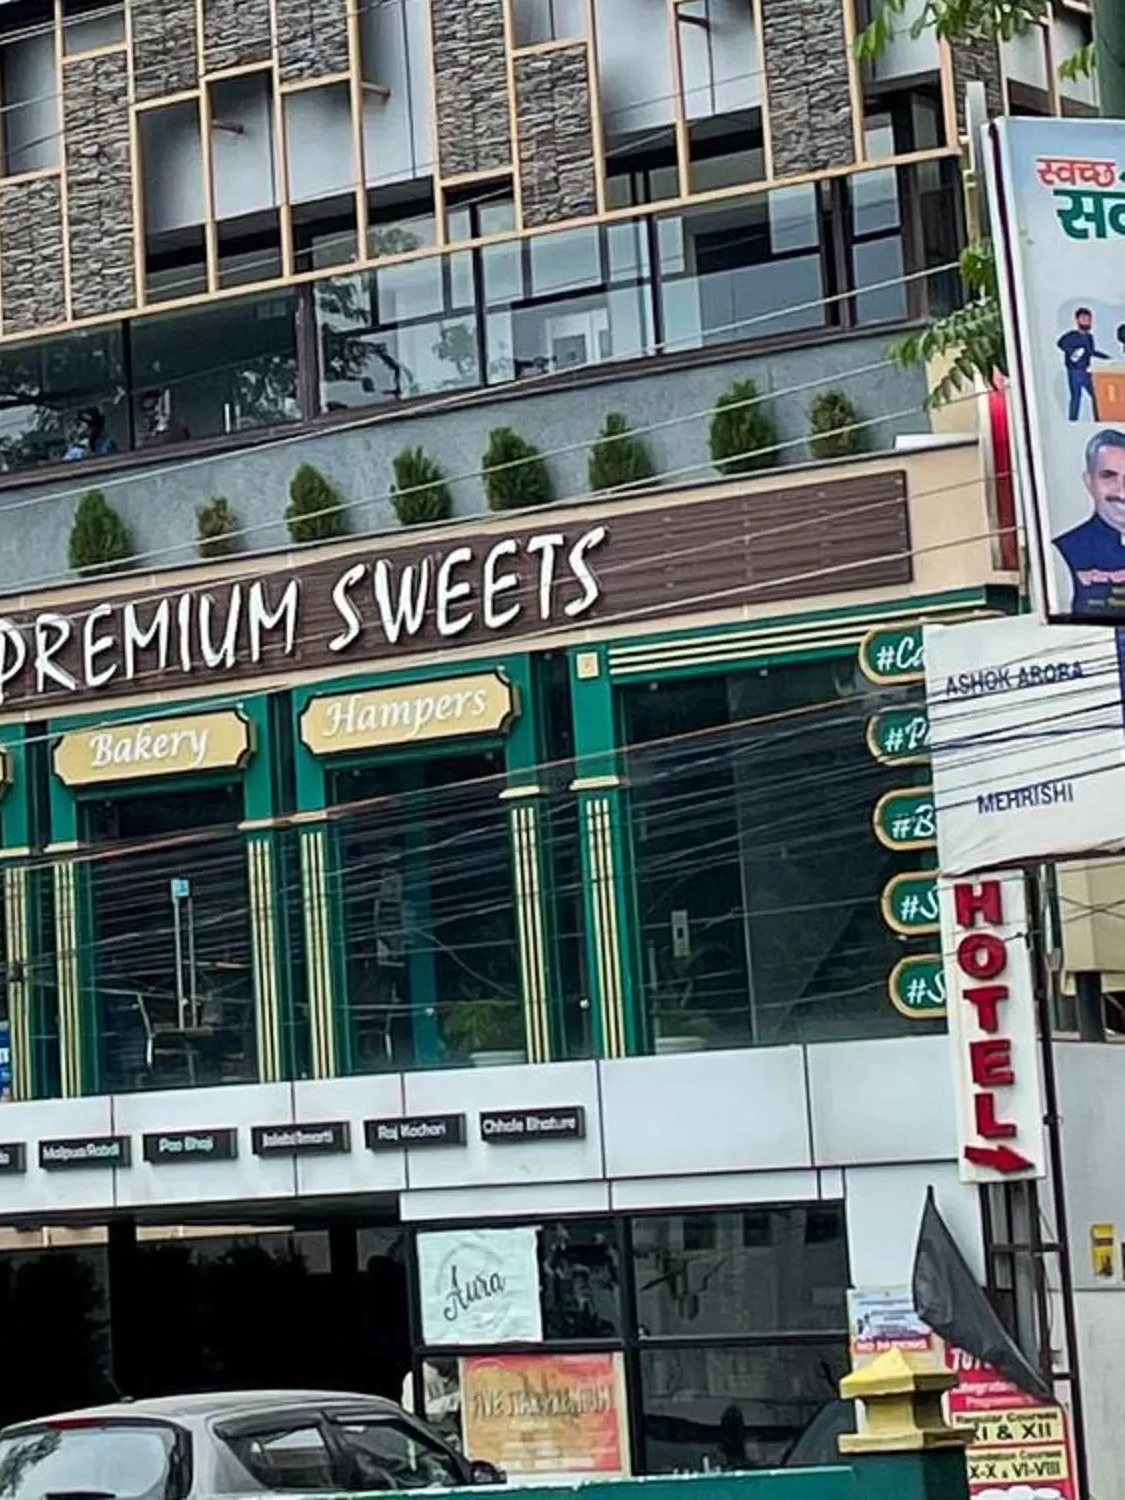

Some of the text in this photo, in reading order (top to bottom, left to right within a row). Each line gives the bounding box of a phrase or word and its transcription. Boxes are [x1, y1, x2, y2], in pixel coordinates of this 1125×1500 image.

[329, 526, 610, 652] SWEETS
[945, 660, 1084, 696] ASHOK ARORA
[322, 686, 487, 740] Hampers
[90, 726, 209, 768] Bakery
[976, 782, 1074, 814] MEHRISHI
[954, 879, 1017, 1139] HOTEL
[442, 1264, 506, 1322] Aura
[996, 1425, 1013, 1440] &
[1021, 1422, 1052, 1440] XII
[969, 1463, 997, 1479] X-X
